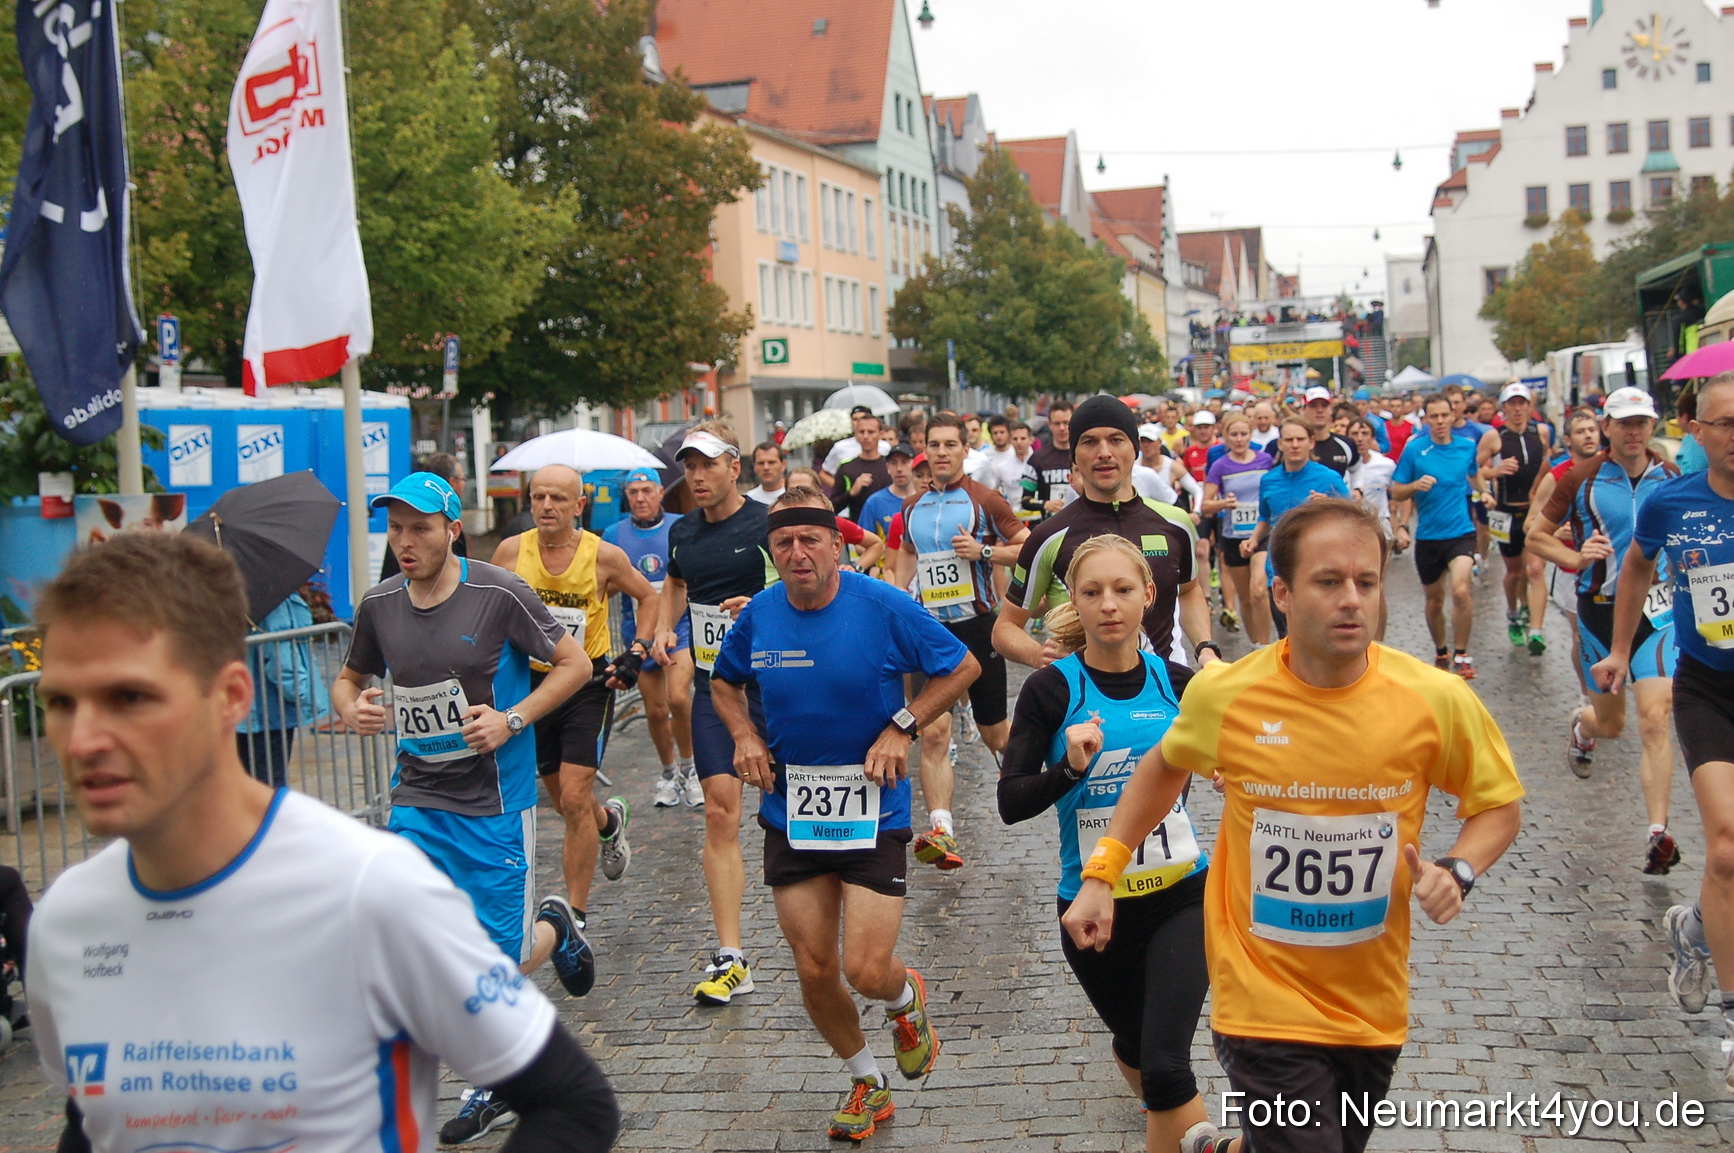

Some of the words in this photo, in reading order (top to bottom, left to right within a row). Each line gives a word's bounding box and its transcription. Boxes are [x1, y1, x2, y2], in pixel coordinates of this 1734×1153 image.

[162, 322, 176, 357] P
[764, 340, 788, 362] D
[926, 563, 960, 586] 153
[1691, 575, 1720, 585] PARTL
[930, 589, 960, 599] Andreas
[1711, 586, 1734, 617] 3
[410, 691, 447, 703] Neumarkt
[400, 700, 465, 735] 2614
[1255, 734, 1289, 745] erima
[788, 773, 818, 782] PARTL
[819, 773, 863, 783] Neumarkt
[1088, 783, 1118, 796] TSG
[1242, 779, 1413, 801] www.deinruecken.de
[797, 785, 868, 817] 2371
[812, 824, 855, 838] Werner
[1080, 817, 1111, 830] PART
[1255, 821, 1300, 841] PARTL
[1304, 828, 1373, 843] Neumarkt
[1265, 845, 1384, 897] 2657
[1126, 874, 1163, 893] Lena
[1291, 908, 1354, 928] Robert
[83, 943, 129, 959] Wolfgang
[123, 1040, 295, 1062] Raiffeisenbank
[120, 1076, 153, 1092] am
[162, 1071, 252, 1092] Rothsee
[262, 1072, 298, 1092] eG
[126, 1108, 199, 1129] kompetent
[213, 1106, 245, 1126] fair
